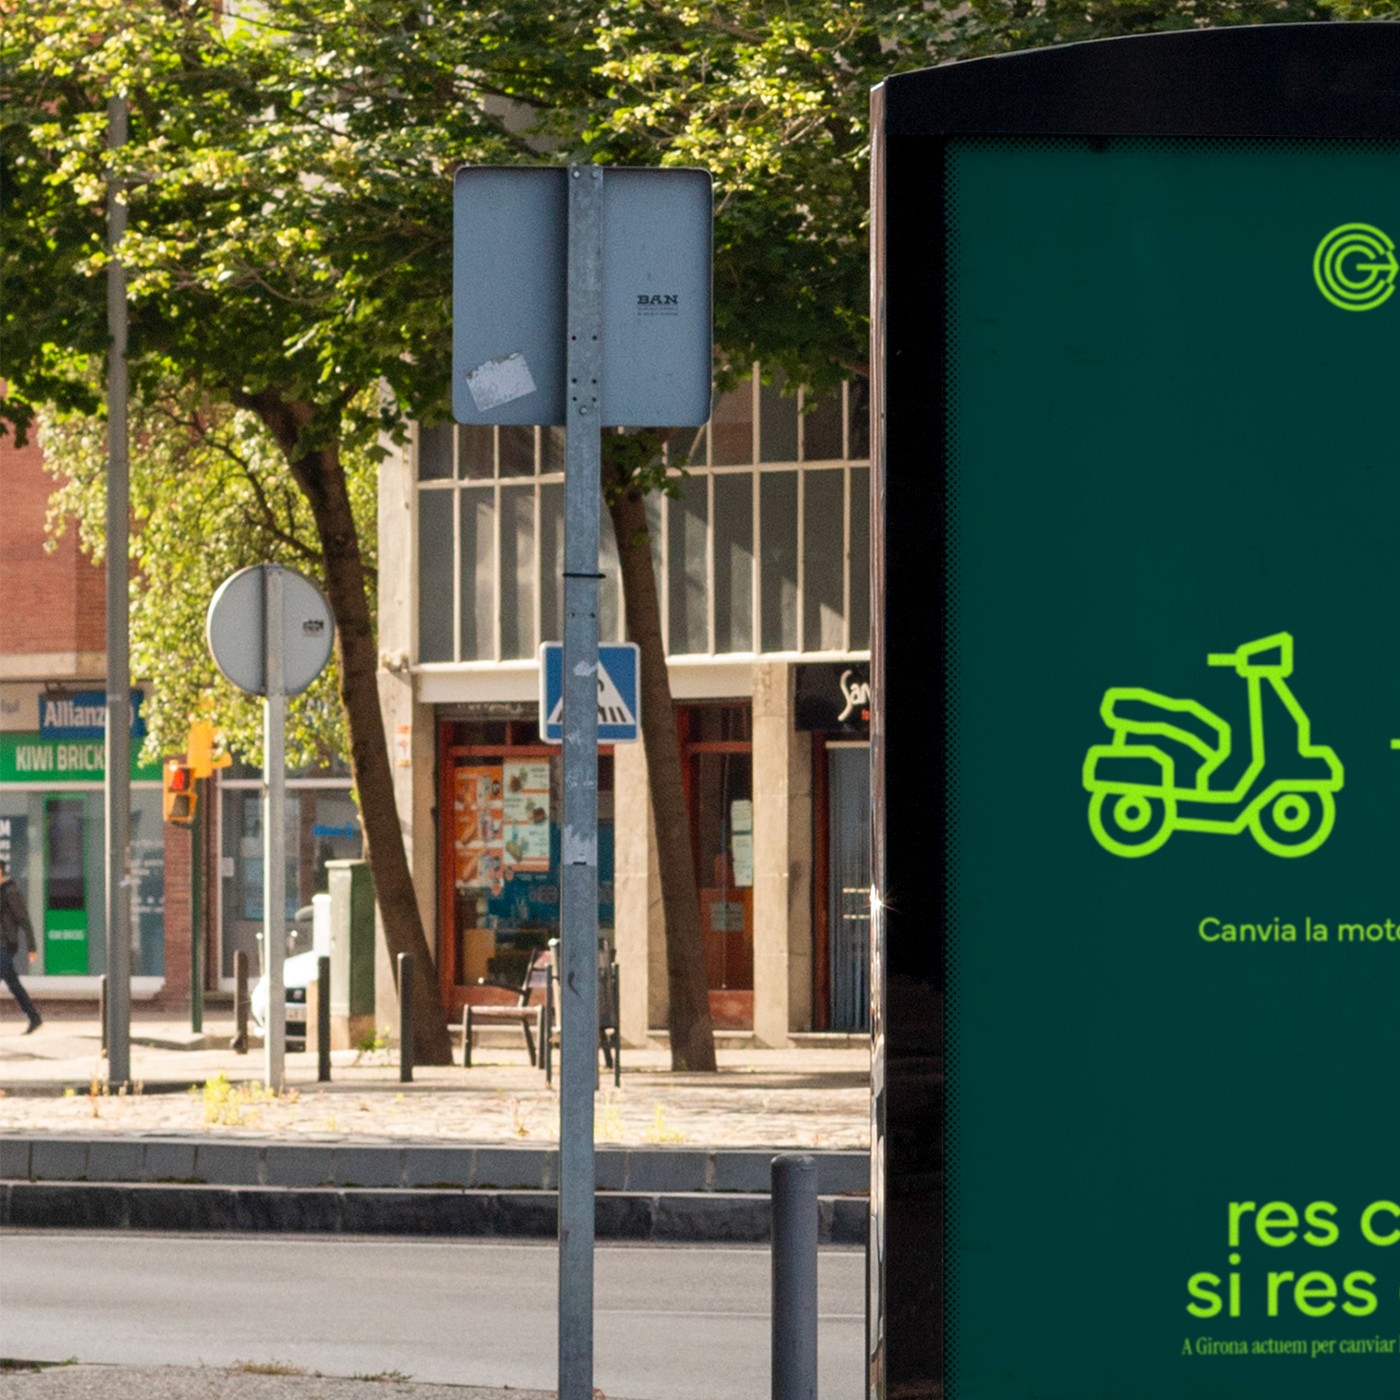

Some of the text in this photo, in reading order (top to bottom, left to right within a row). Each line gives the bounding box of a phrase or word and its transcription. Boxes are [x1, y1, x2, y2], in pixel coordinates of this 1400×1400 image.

[637, 294, 678, 305] BAN
[44, 701, 106, 727] Allianz
[16, 745, 106, 770] KIWI BRICK
[1199, 917, 1297, 942] Canvia
[1306, 917, 1328, 942] la
[1229, 1201, 1339, 1248] res
[1186, 1252, 1241, 1318] si
[1267, 1268, 1377, 1317] res
[1182, 1338, 1192, 1355] A
[1196, 1337, 1248, 1355] Girona
[1252, 1338, 1307, 1354] actuem
[1311, 1338, 1336, 1358] per
[1339, 1335, 1398, 1353] canviar
